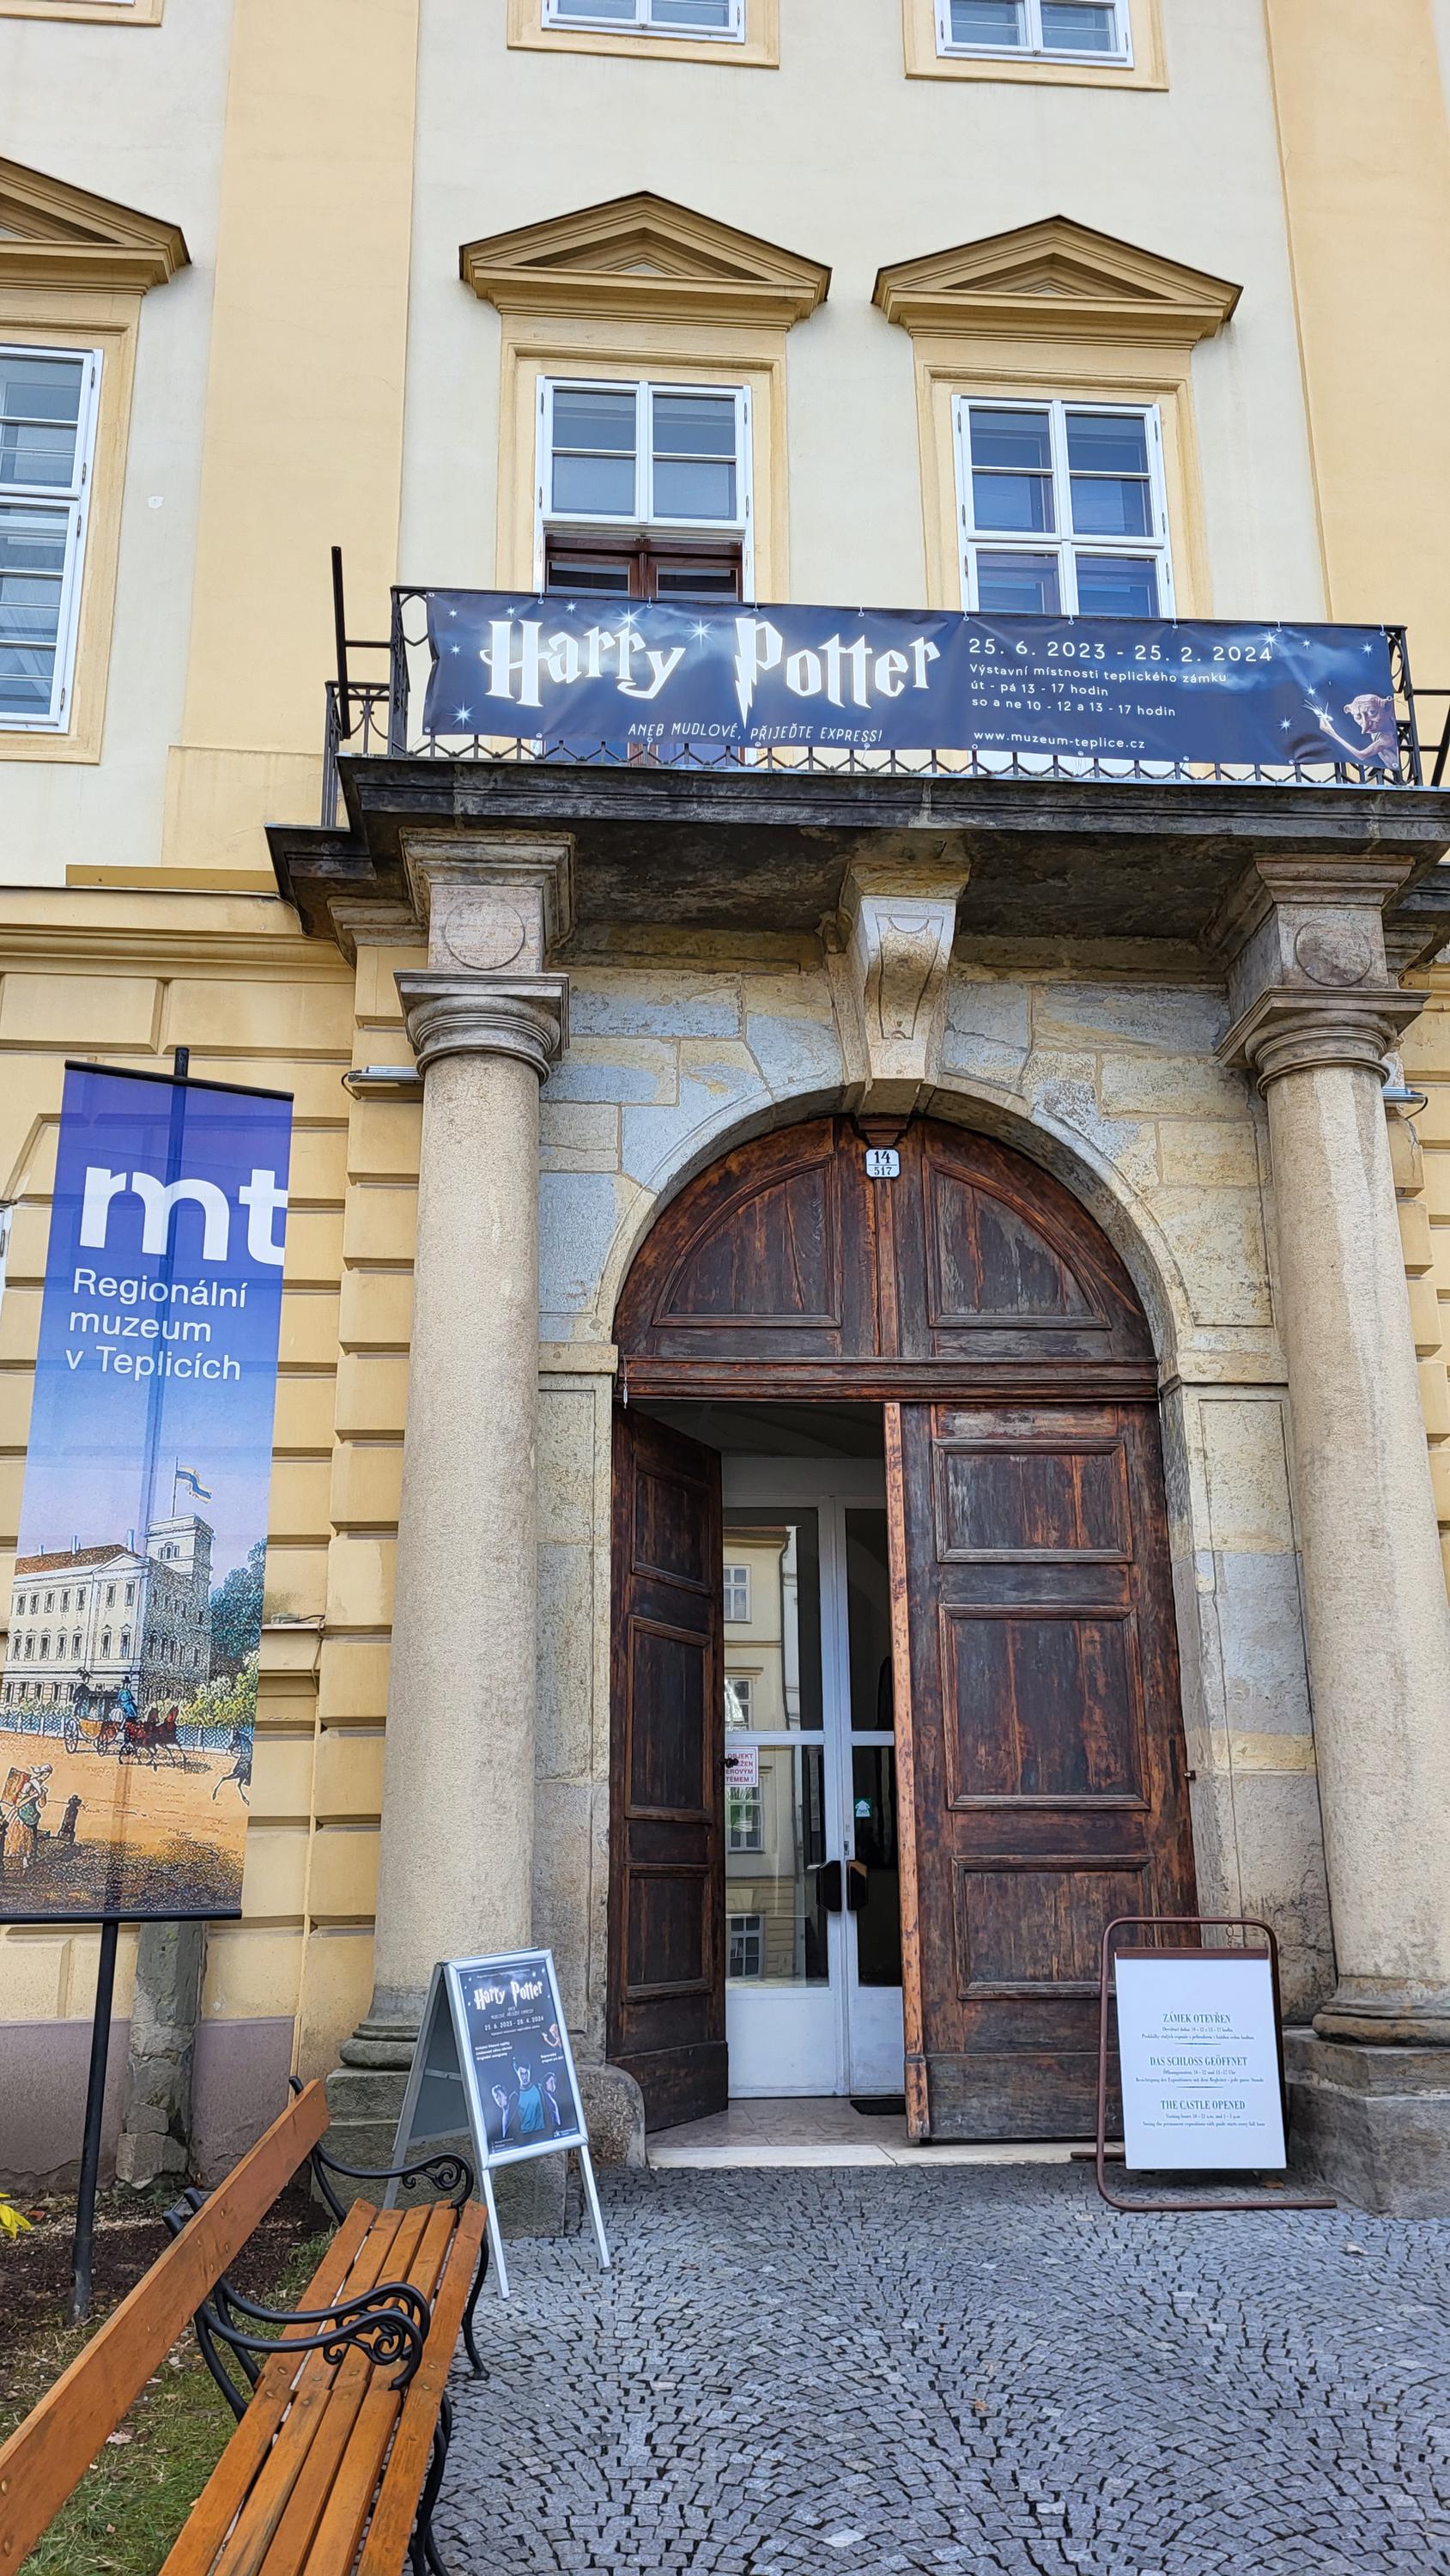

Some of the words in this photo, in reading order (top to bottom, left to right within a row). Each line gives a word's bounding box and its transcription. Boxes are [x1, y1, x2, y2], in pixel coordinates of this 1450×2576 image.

[968, 638, 1004, 655] 25.
[1016, 641, 1036, 656] 6.
[1047, 641, 1106, 659] 2023
[1134, 645, 1170, 662] 25.
[1180, 647, 1202, 663] 2.
[1212, 646, 1272, 662] 2024
[479, 619, 686, 708] Harry
[735, 617, 941, 730] Potter
[969, 663, 1028, 677] Výstavní
[1033, 666, 1100, 679] místnosti
[1103, 671, 1177, 683] teplického
[1182, 672, 1227, 683] zámku
[971, 679, 986, 690] út
[1000, 683, 1017, 694] pá
[1021, 683, 1035, 694] 13
[1051, 683, 1065, 694] 17
[1071, 684, 1109, 696] hodin
[971, 698, 988, 707] so
[992, 699, 1000, 708] a
[1005, 700, 1022, 709] ne
[1026, 700, 1041, 711] 10
[1057, 701, 1072, 712] 12
[1077, 702, 1085, 712] a
[1089, 702, 1104, 713] 13
[1118, 704, 1131, 714] 17
[1137, 705, 1176, 716] hodin
[628, 722, 664, 737] ANEB
[670, 721, 743, 740] MUDLOVÉ,
[749, 722, 812, 741] PŘIJEĎTE
[819, 726, 883, 743] EXPRESS!
[974, 732, 1146, 750] www.muzeum-teplice.cz
[874, 1150, 891, 1164] 14
[874, 1166, 893, 1176] 517
[73, 1267, 248, 1308] Regionální
[69, 1310, 212, 1343] muzeum
[65, 1349, 84, 1370] v
[95, 1346, 241, 1382] Teplicích
[473, 1986, 505, 2010] Harry
[510, 1980, 543, 2008] Potter
[1162, 2011, 1192, 2024] ZÁMEK
[1193, 2012, 1231, 2024] OTEVŘEN
[1150, 2056, 1166, 2067] DAS
[1167, 2056, 1203, 2067] SCHLOSS
[1204, 2054, 1248, 2067] GEÖFFNET
[1161, 2099, 1179, 2110] THE
[1180, 2099, 1210, 2110] CASTLE
[1212, 2099, 1246, 2110] OPENED
